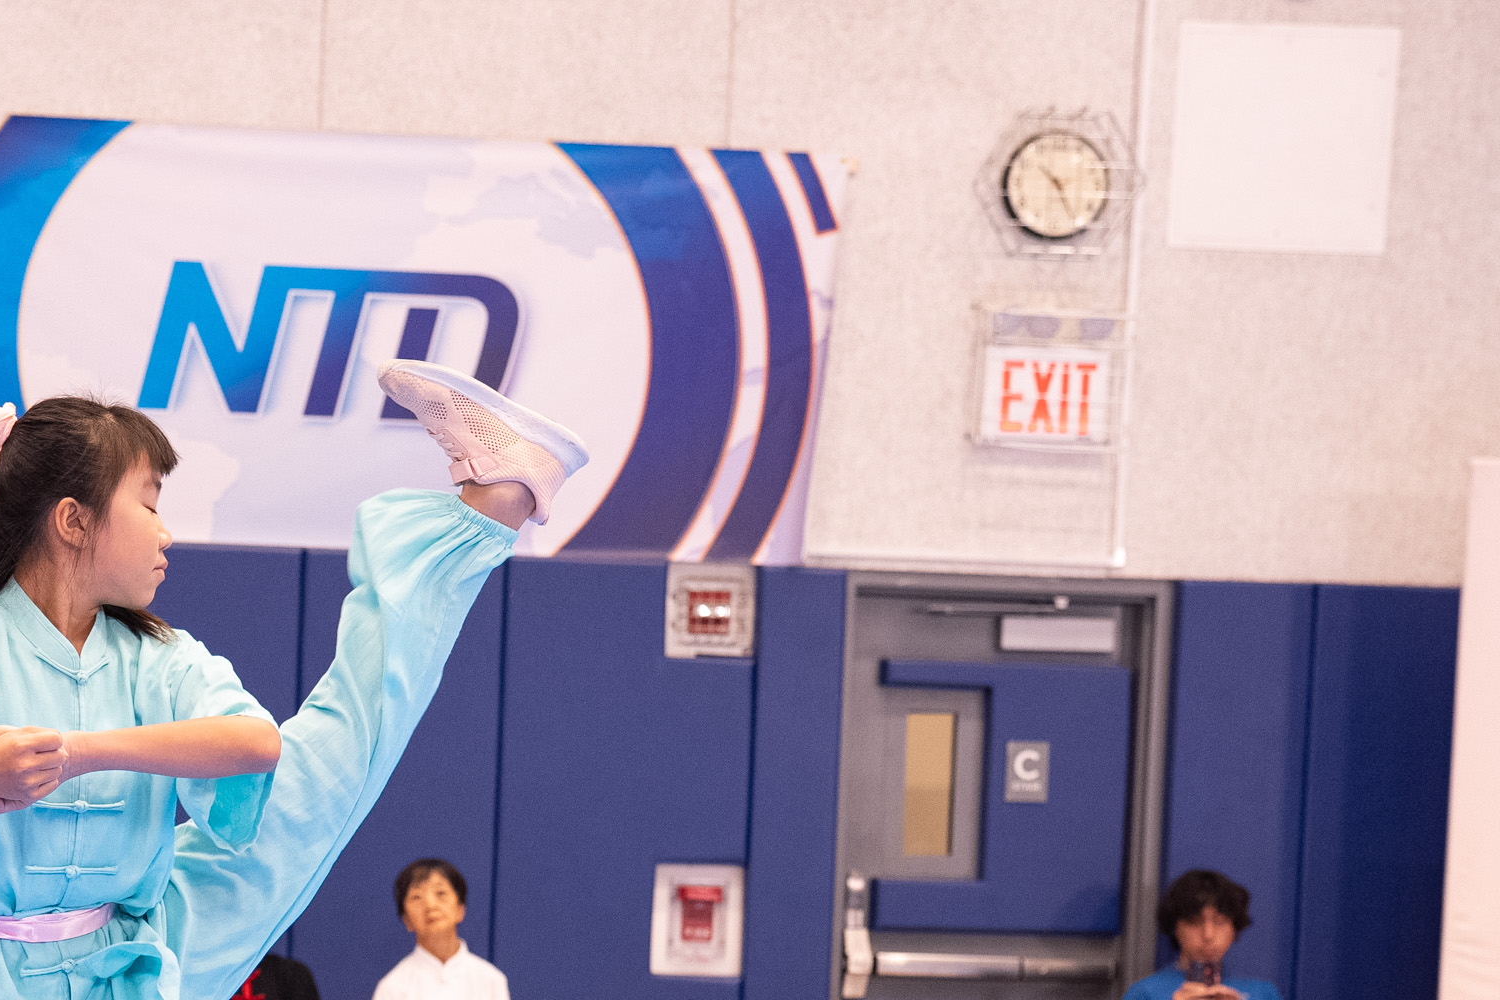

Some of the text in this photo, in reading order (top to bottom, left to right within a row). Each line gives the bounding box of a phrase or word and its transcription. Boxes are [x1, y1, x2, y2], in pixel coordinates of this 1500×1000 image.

[137, 261, 520, 420] NTD
[1000, 360, 1097, 436] EXIT
[1013, 749, 1040, 781] C
